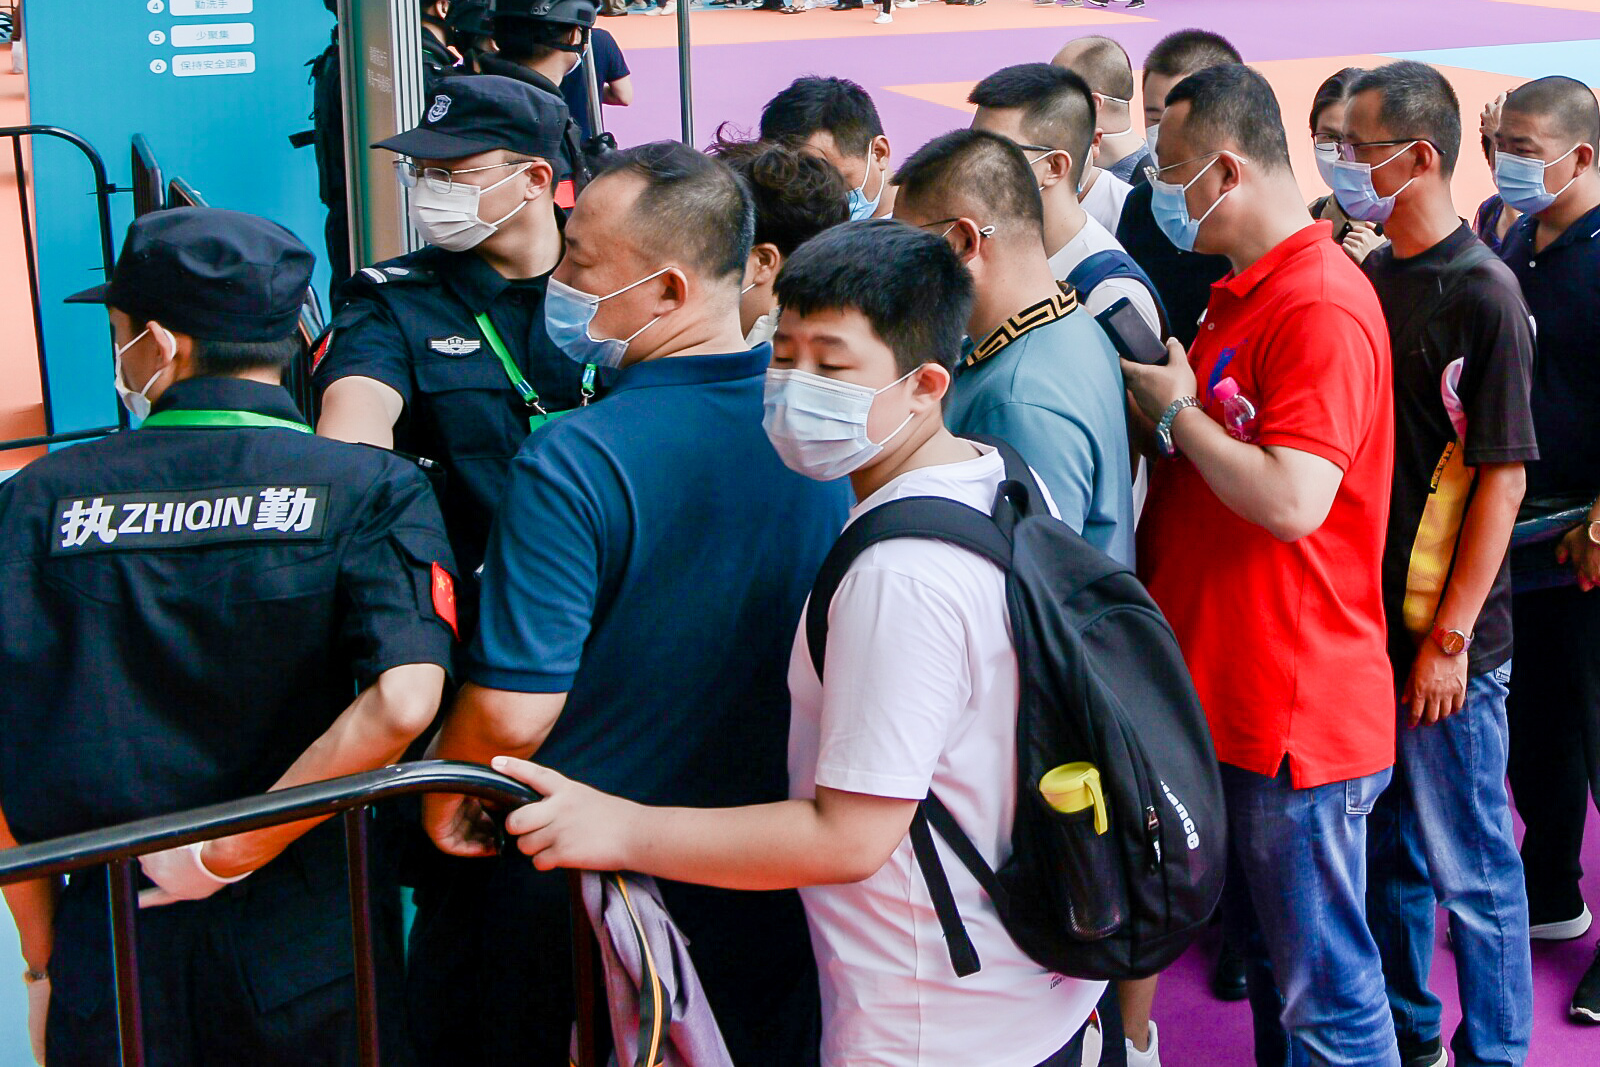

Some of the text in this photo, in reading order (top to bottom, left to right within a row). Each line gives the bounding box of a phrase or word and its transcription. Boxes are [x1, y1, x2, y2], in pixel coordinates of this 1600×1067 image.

[194, 0, 228, 10] 勤洗手
[196, 30, 230, 40] 少聚集
[180, 59, 248, 71] 保持安全距离
